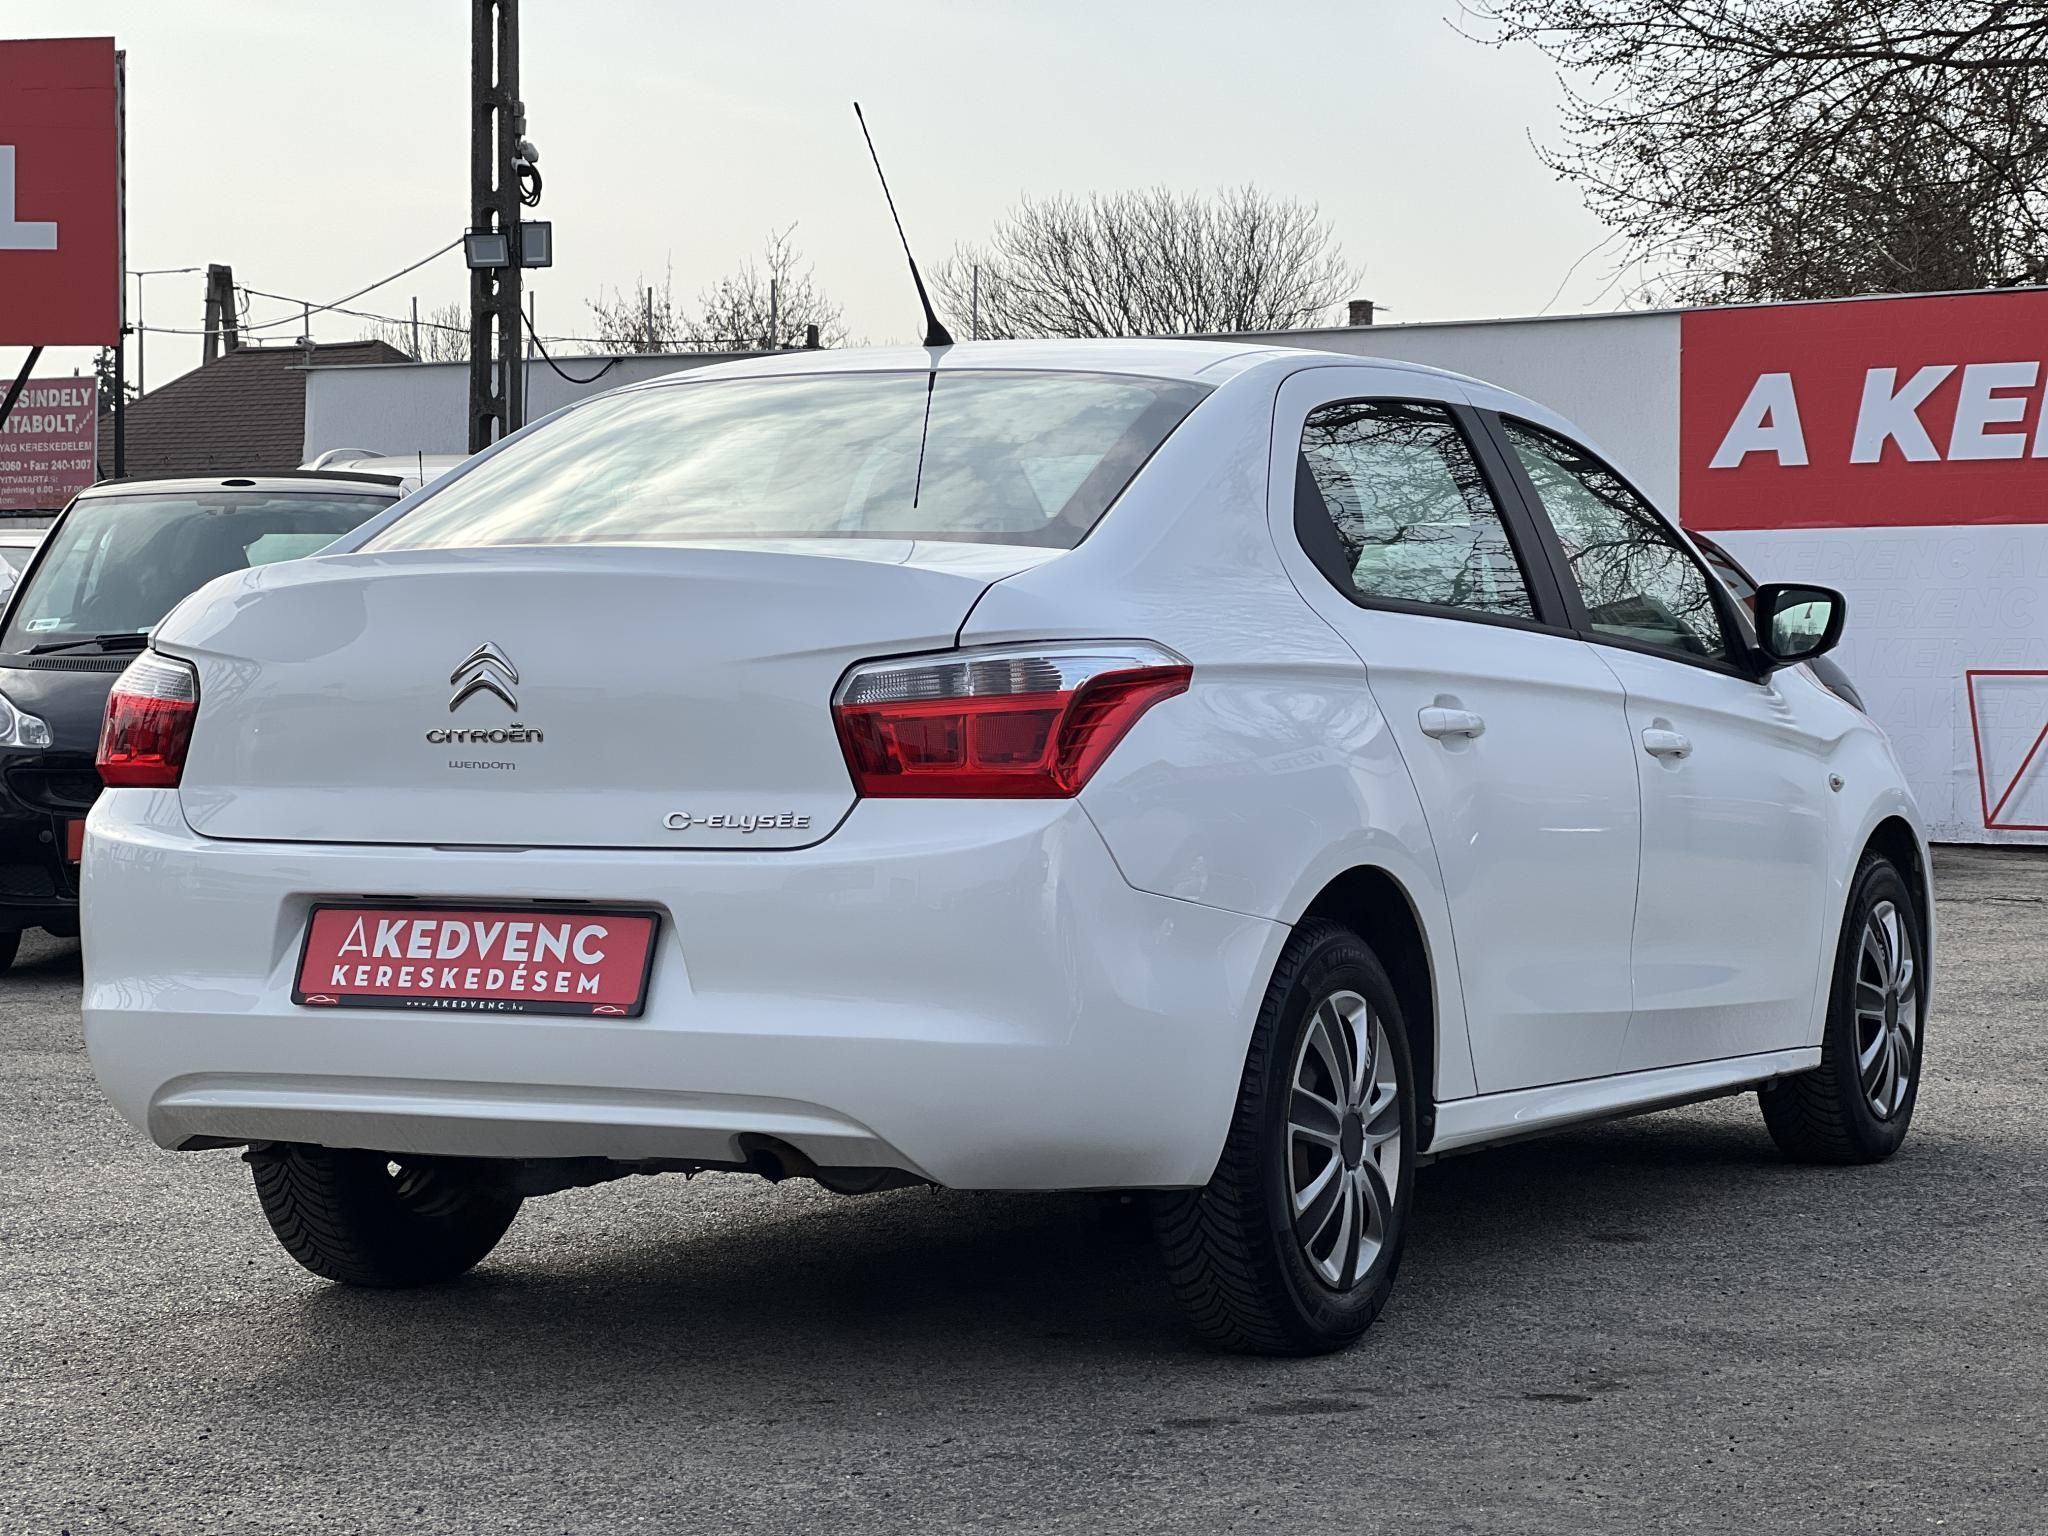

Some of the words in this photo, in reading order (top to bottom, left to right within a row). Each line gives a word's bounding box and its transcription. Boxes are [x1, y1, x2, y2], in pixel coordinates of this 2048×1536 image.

[1709, 371, 1809, 468] A
[1849, 361, 2048, 464] KE
[19, 441, 92, 453] KERESKEDELEM
[30, 459, 49, 471] Fax:
[51, 459, 92, 471] 240-1307
[426, 722, 544, 744] CITROËN
[662, 811, 811, 833] C-ELYSÉE
[330, 964, 601, 995] KERESKEDÉSEM
